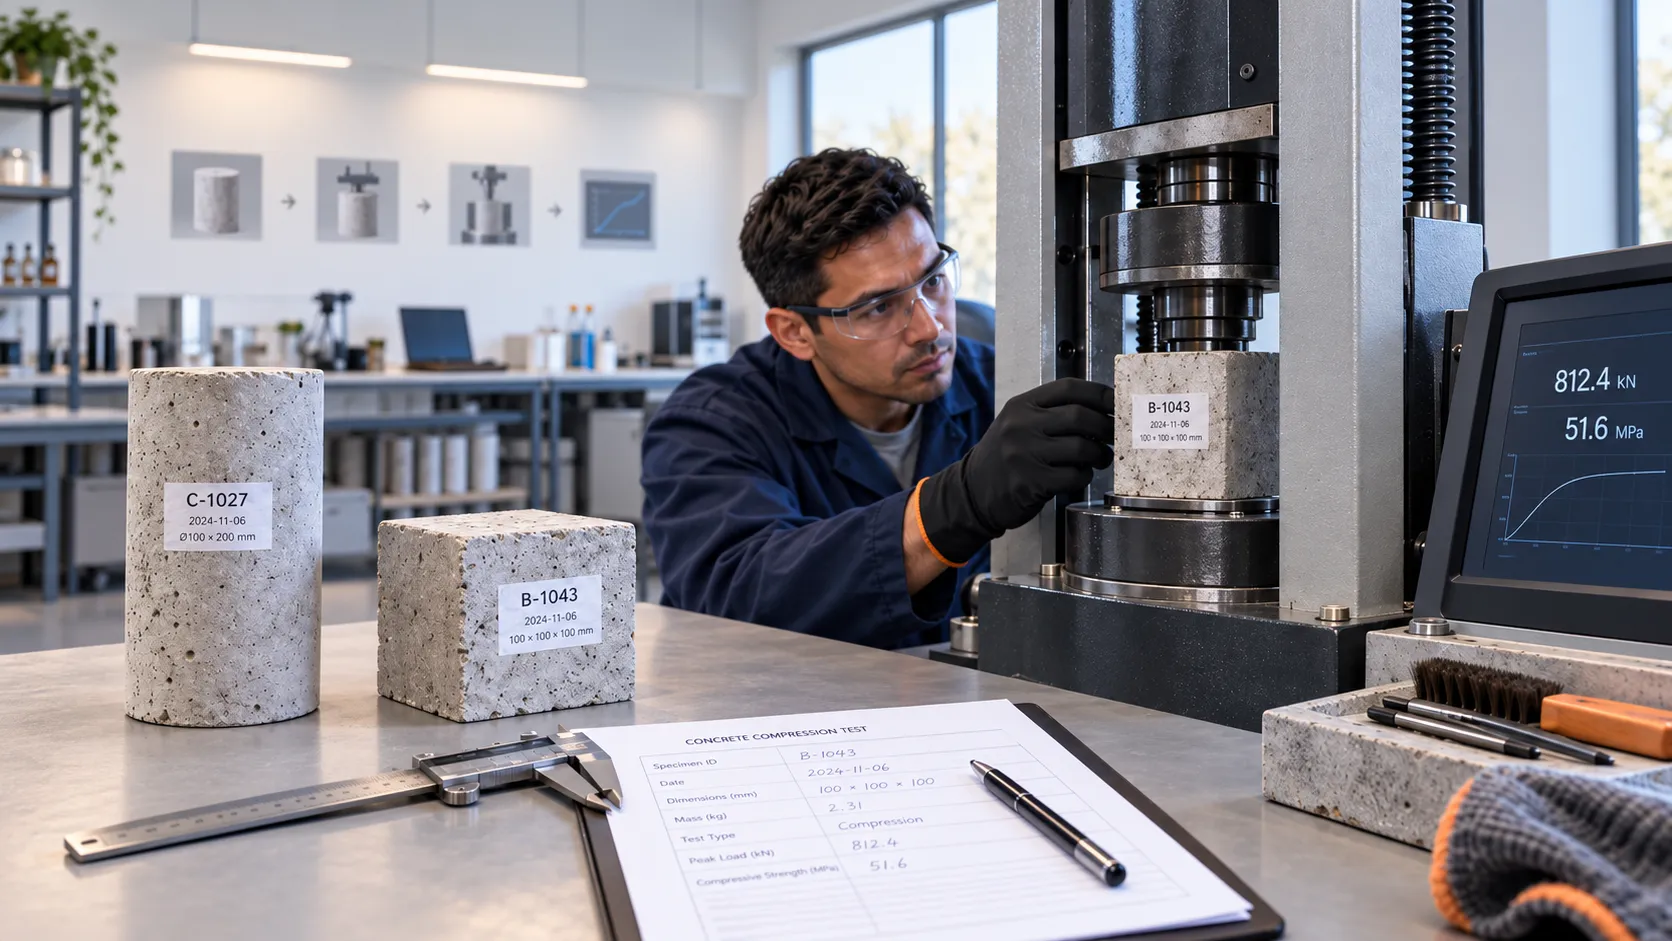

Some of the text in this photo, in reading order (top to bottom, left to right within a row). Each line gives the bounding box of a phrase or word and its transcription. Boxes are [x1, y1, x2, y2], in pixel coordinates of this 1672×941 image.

[1554, 366, 1636, 393] 812.4 kN
[1148, 400, 1190, 413] B-1043
[1150, 420, 1190, 429] 2024-11-06
[1565, 415, 1644, 441] 51.6 MPa
[1140, 433, 1151, 442] 100
[1158, 433, 1169, 442] 100
[1176, 433, 1187, 442] 100
[186, 492, 248, 508] C-1027
[188, 515, 246, 526] 2024-11-06
[179, 532, 206, 542] Ø100
[216, 532, 235, 542] 200
[237, 533, 256, 541] mm
[521, 587, 578, 607] B-1043
[524, 611, 577, 626] 2024-11-06
[509, 634, 526, 645] 100
[535, 631, 551, 641] 100
[560, 628, 576, 638] 100
[577, 627, 594, 636] mm
[685, 725, 868, 746] CONCRETE COMPRESSION TEST
[800, 748, 856, 761] B-1043
[653, 758, 718, 770] Specimen ID
[807, 763, 890, 777] 2024-11-06
[659, 779, 685, 787] Date
[819, 785, 842, 794] 100
[864, 782, 888, 791] 100
[911, 777, 935, 787] 100
[666, 791, 758, 805] Dimensions (mm)
[828, 801, 862, 813] 2.31
[674, 812, 728, 824] Mass (kg)
[838, 815, 924, 830] Compression
[680, 832, 736, 844] Test Type
[852, 837, 899, 851] 812.4
[689, 849, 775, 865] Peak Load (kN)
[869, 857, 908, 872] 51.6
[696, 865, 840, 887] Compressive Strength (MPa)
